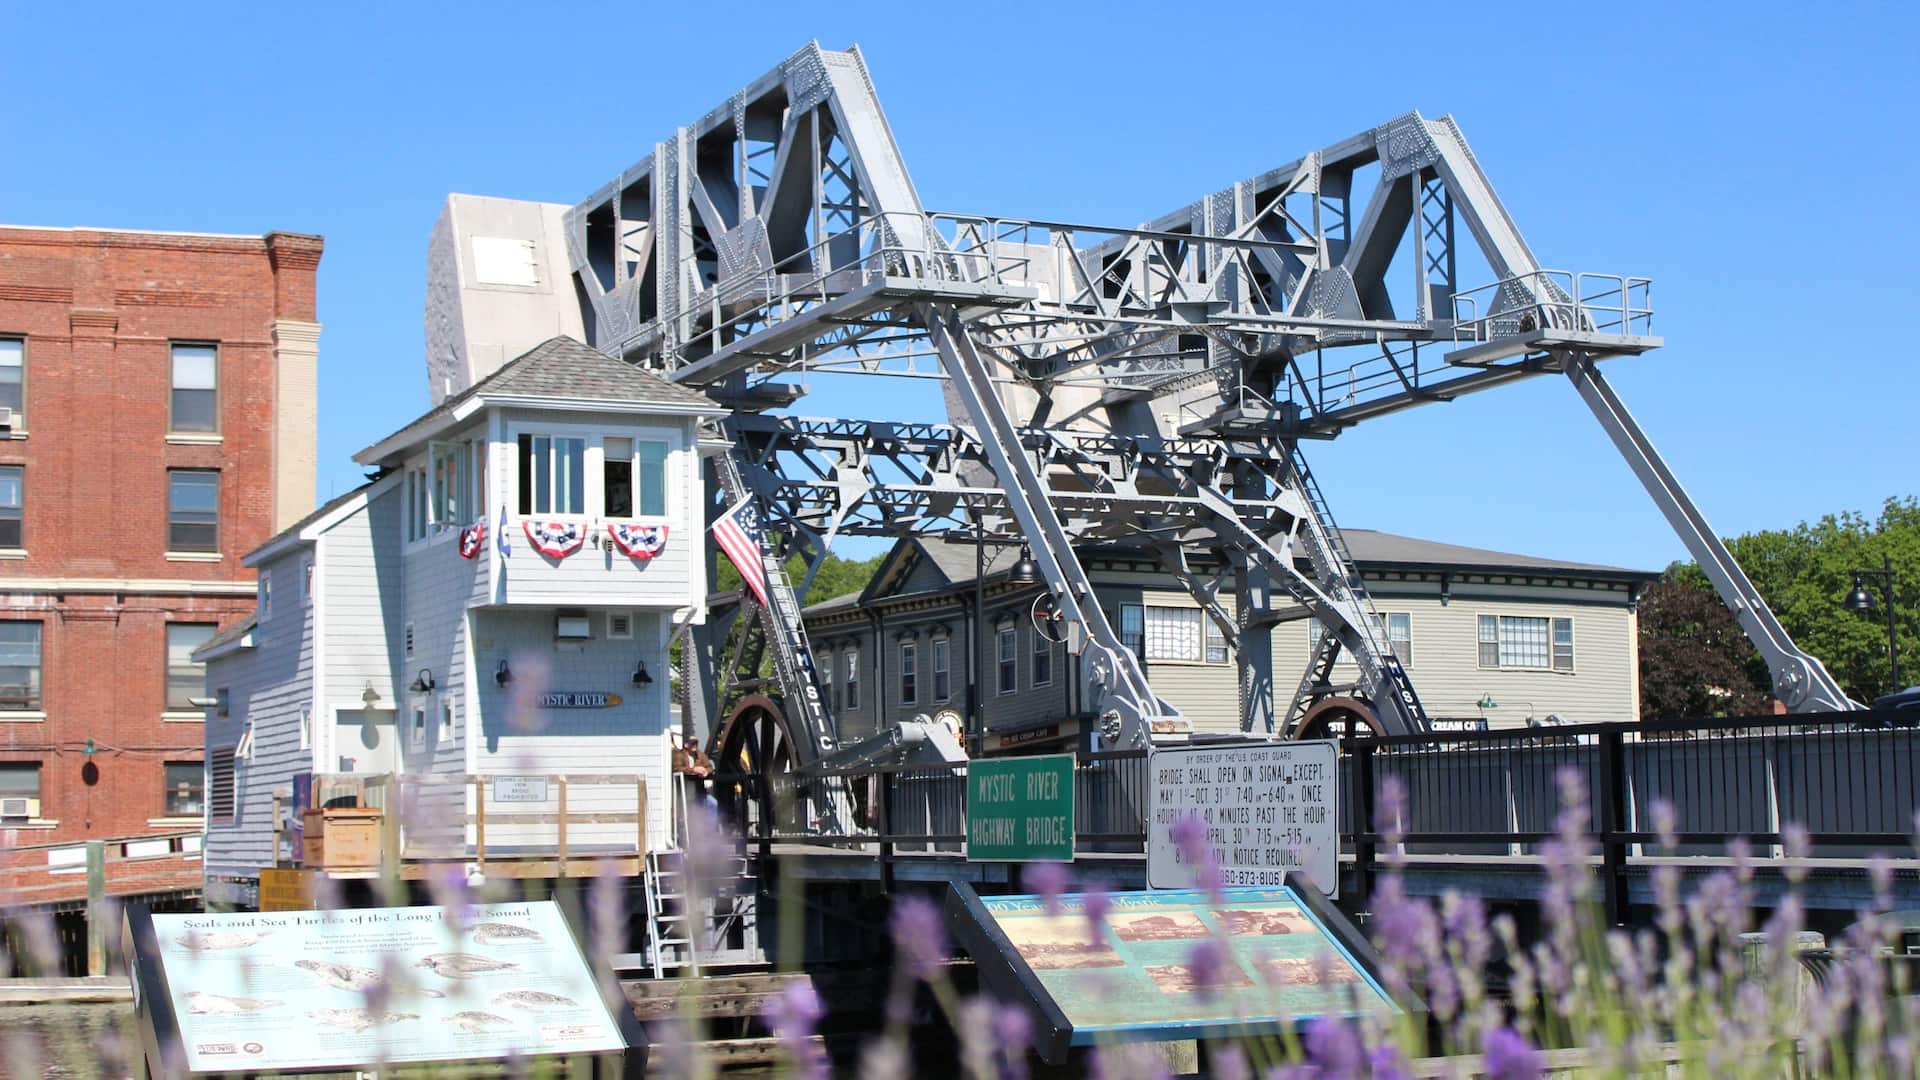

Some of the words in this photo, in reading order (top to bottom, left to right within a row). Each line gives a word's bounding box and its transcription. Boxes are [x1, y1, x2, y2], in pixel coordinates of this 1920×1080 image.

[575, 694, 605, 705] RIVER
[796, 653, 833, 750] MYSTIC
[1388, 661, 1429, 738] MYSTI
[1431, 721, 1463, 731] CREAM
[1464, 721, 1486, 731] CAFE
[1250, 752, 1269, 762] COAST
[1272, 752, 1293, 761] GUARD
[1160, 769, 1183, 785] BRIDGE
[1189, 767, 1211, 784] SHALL
[1217, 766, 1237, 783] OPEN
[1243, 765, 1253, 783] ON
[979, 773, 1016, 803] MYSTIC
[1027, 771, 1059, 801] RIVER
[1160, 788, 1174, 804] MAY
[1301, 784, 1322, 802] ONCE
[1203, 807, 1214, 824] 40
[1219, 807, 1250, 824] MINUTES
[1256, 807, 1276, 824] PAST
[1283, 807, 1297, 824] THE
[1303, 806, 1326, 824] HOUR
[972, 818, 1016, 847] HIGHWAY
[1026, 816, 1066, 846] BRIDGE
[1233, 848, 1259, 866] NOTICE
[183, 919, 222, 928] Seals
[227, 918, 255, 928] and
[261, 918, 287, 927] Sea
[350, 914, 363, 923] of
[368, 914, 390, 922] the
[396, 913, 433, 923] Long
[486, 907, 531, 917] Sound
